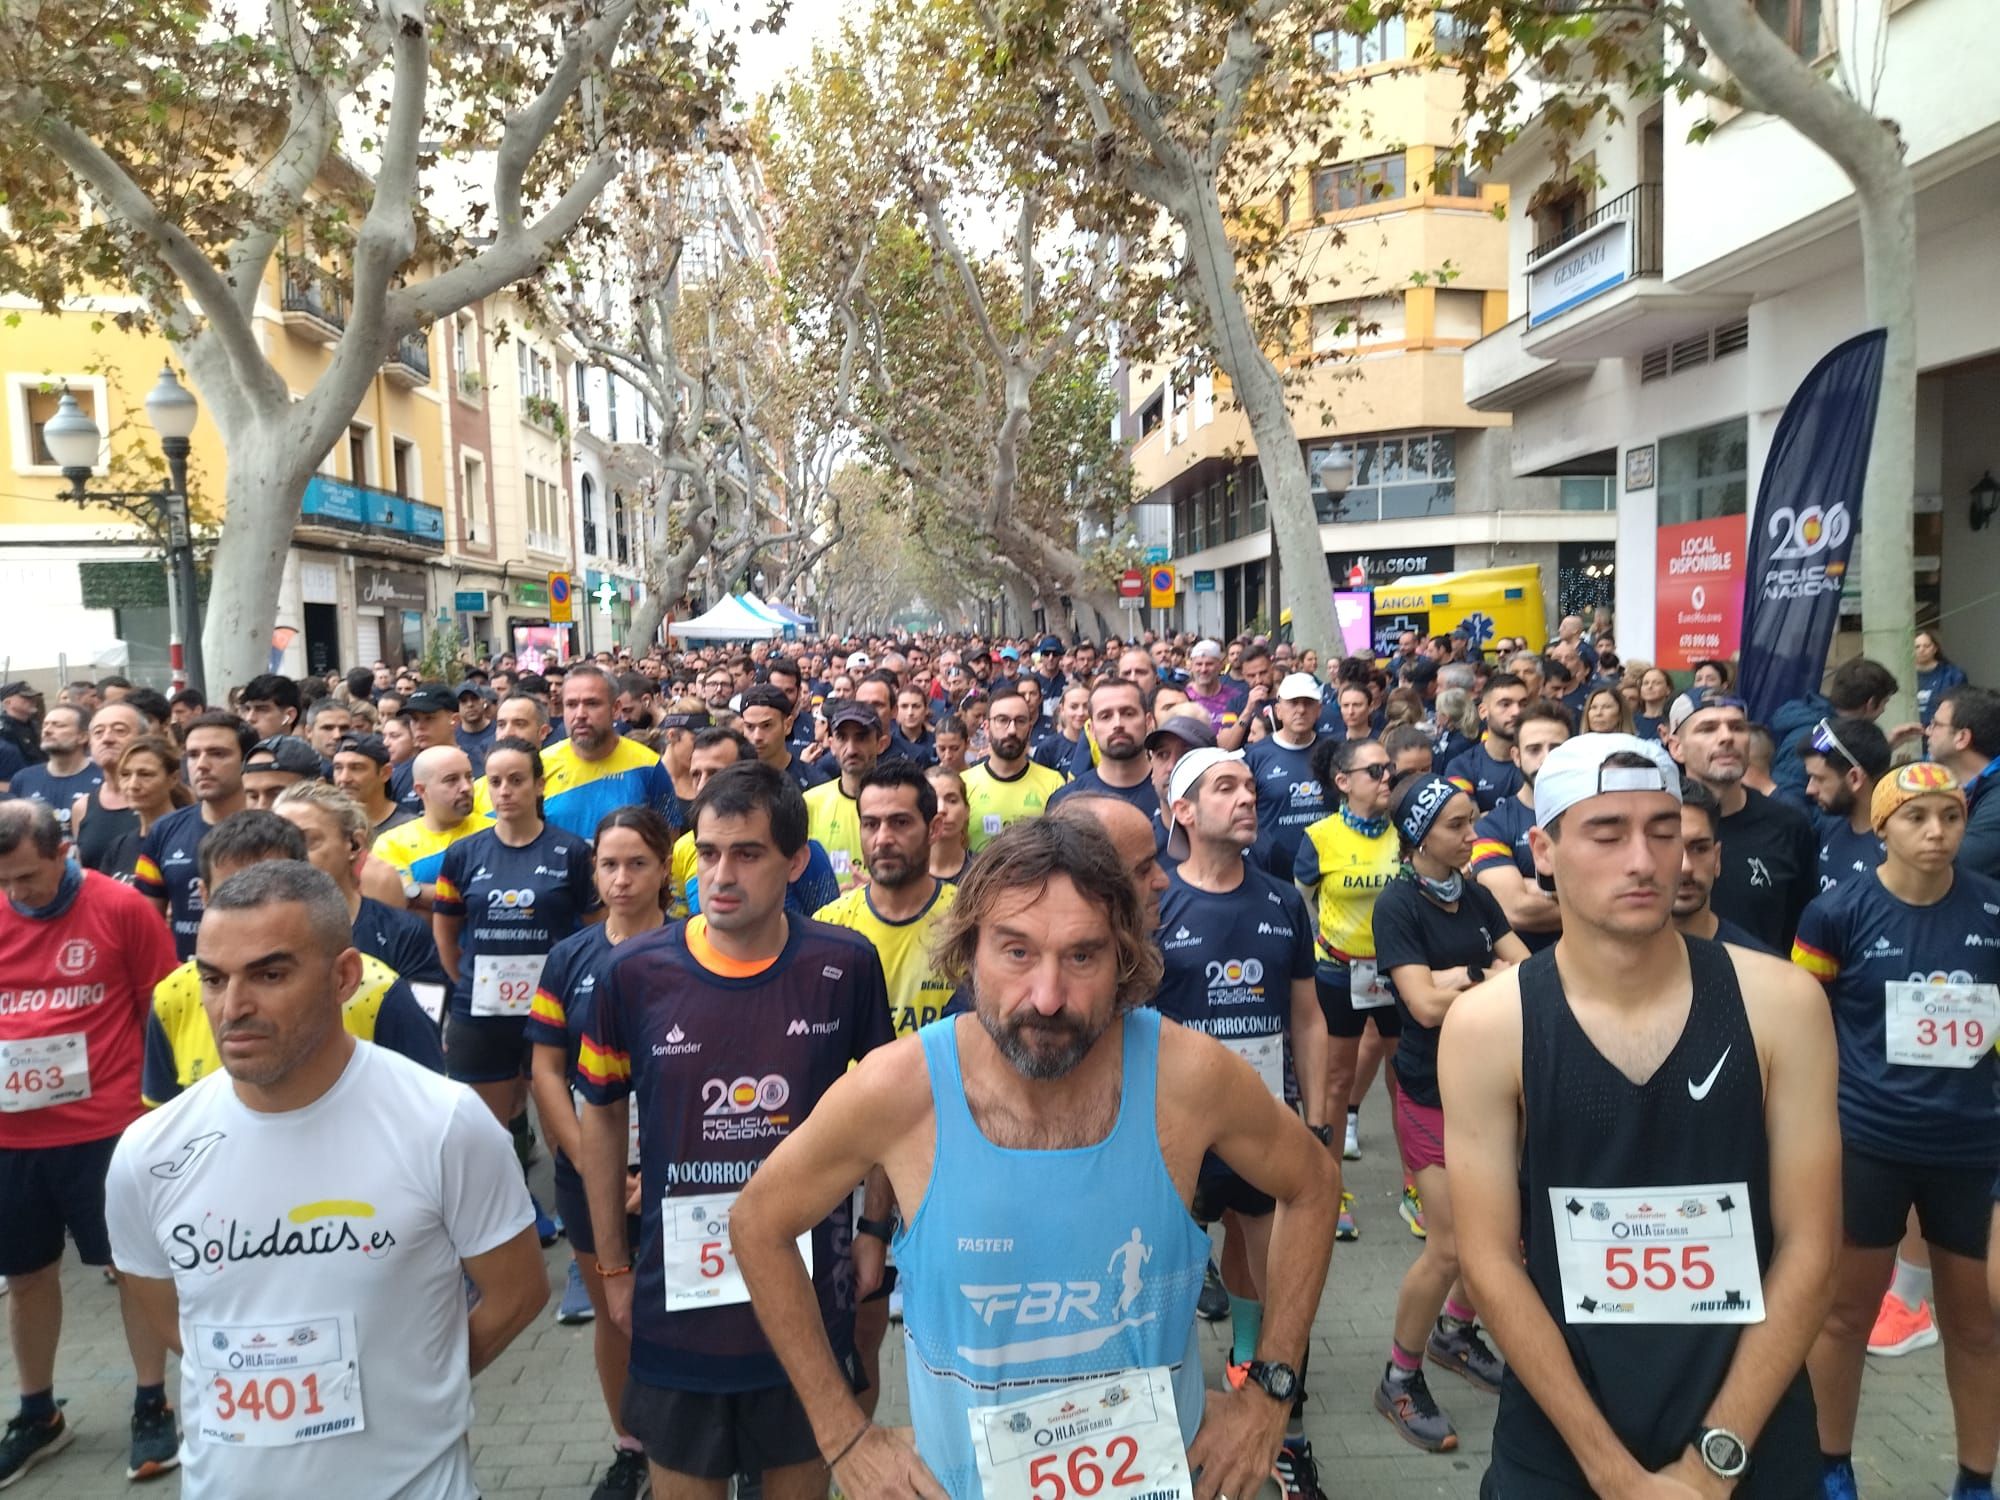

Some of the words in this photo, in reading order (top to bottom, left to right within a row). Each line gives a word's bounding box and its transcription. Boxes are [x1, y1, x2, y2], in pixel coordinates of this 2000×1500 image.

[1554, 244, 1605, 287] GESDENIA
[1768, 501, 1850, 560] 200
[1681, 536, 1716, 556] LOCAL
[1669, 552, 1732, 575] DISPONIBLE
[1403, 778, 1449, 836] BASX
[1343, 875, 1396, 887] BALEA
[1164, 937, 1203, 950] Santander
[1205, 958, 1263, 988] 200
[50, 983, 105, 1010] DURO
[500, 981, 530, 1001] 92
[1916, 1018, 1984, 1047] 319
[652, 1042, 702, 1056] Santander
[5, 1065, 65, 1095] 463
[702, 1074, 790, 1116] 200
[703, 1117, 770, 1130] POLICIA
[703, 1126, 789, 1141] NACIONAL
[668, 1160, 765, 1184] #YOCORROC
[1632, 1224, 1652, 1237] HLA
[957, 1238, 1014, 1251] FASTER
[1605, 1245, 1715, 1290] 555
[959, 1281, 1100, 1327] FBR
[245, 1352, 263, 1366] HLA
[214, 1373, 324, 1421] 3401
[1048, 1407, 1089, 1424] Santander
[1055, 1424, 1076, 1442] HLA
[1029, 1436, 1146, 1500] 562
